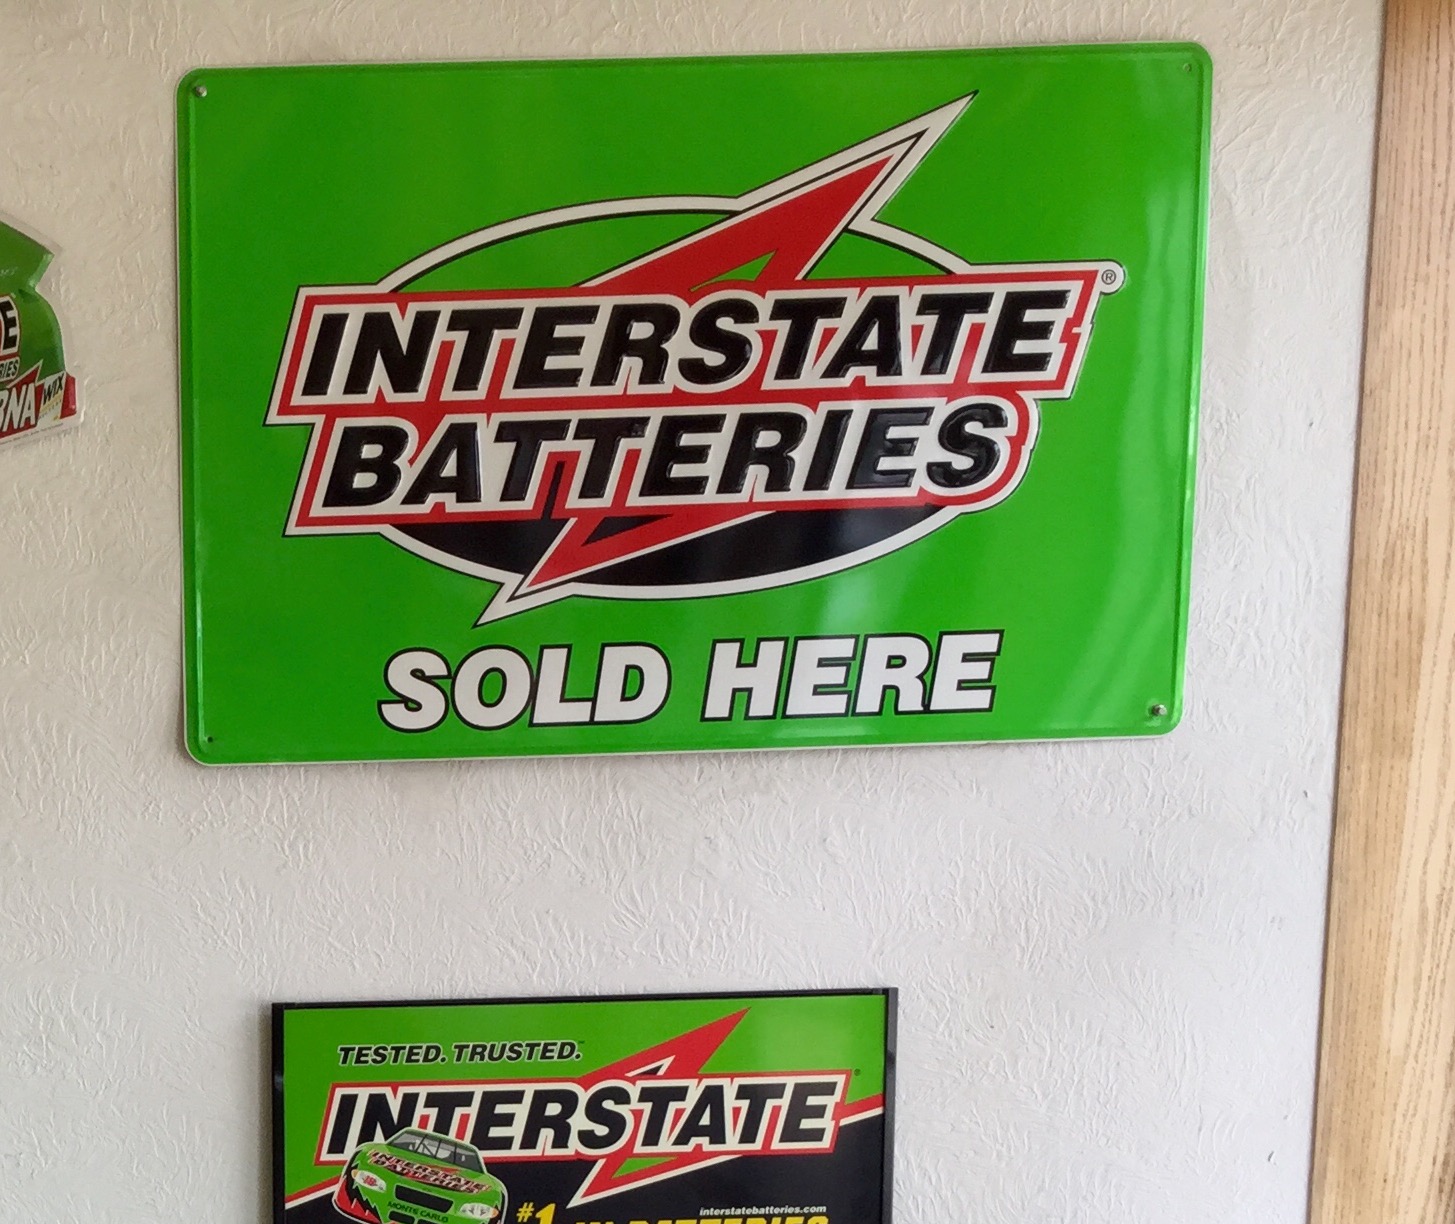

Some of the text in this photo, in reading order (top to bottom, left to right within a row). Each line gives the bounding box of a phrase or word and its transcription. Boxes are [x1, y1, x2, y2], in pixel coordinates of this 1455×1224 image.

[301, 288, 1071, 398] INTERSTATE
[320, 400, 1014, 510] BATTERIES
[378, 630, 1005, 732] SOLD HERE
[337, 1040, 583, 1066] TESTED. TRUSTED.
[326, 1080, 841, 1155] INTERSTATE
[699, 1203, 827, 1216] interstatebatteries.com
